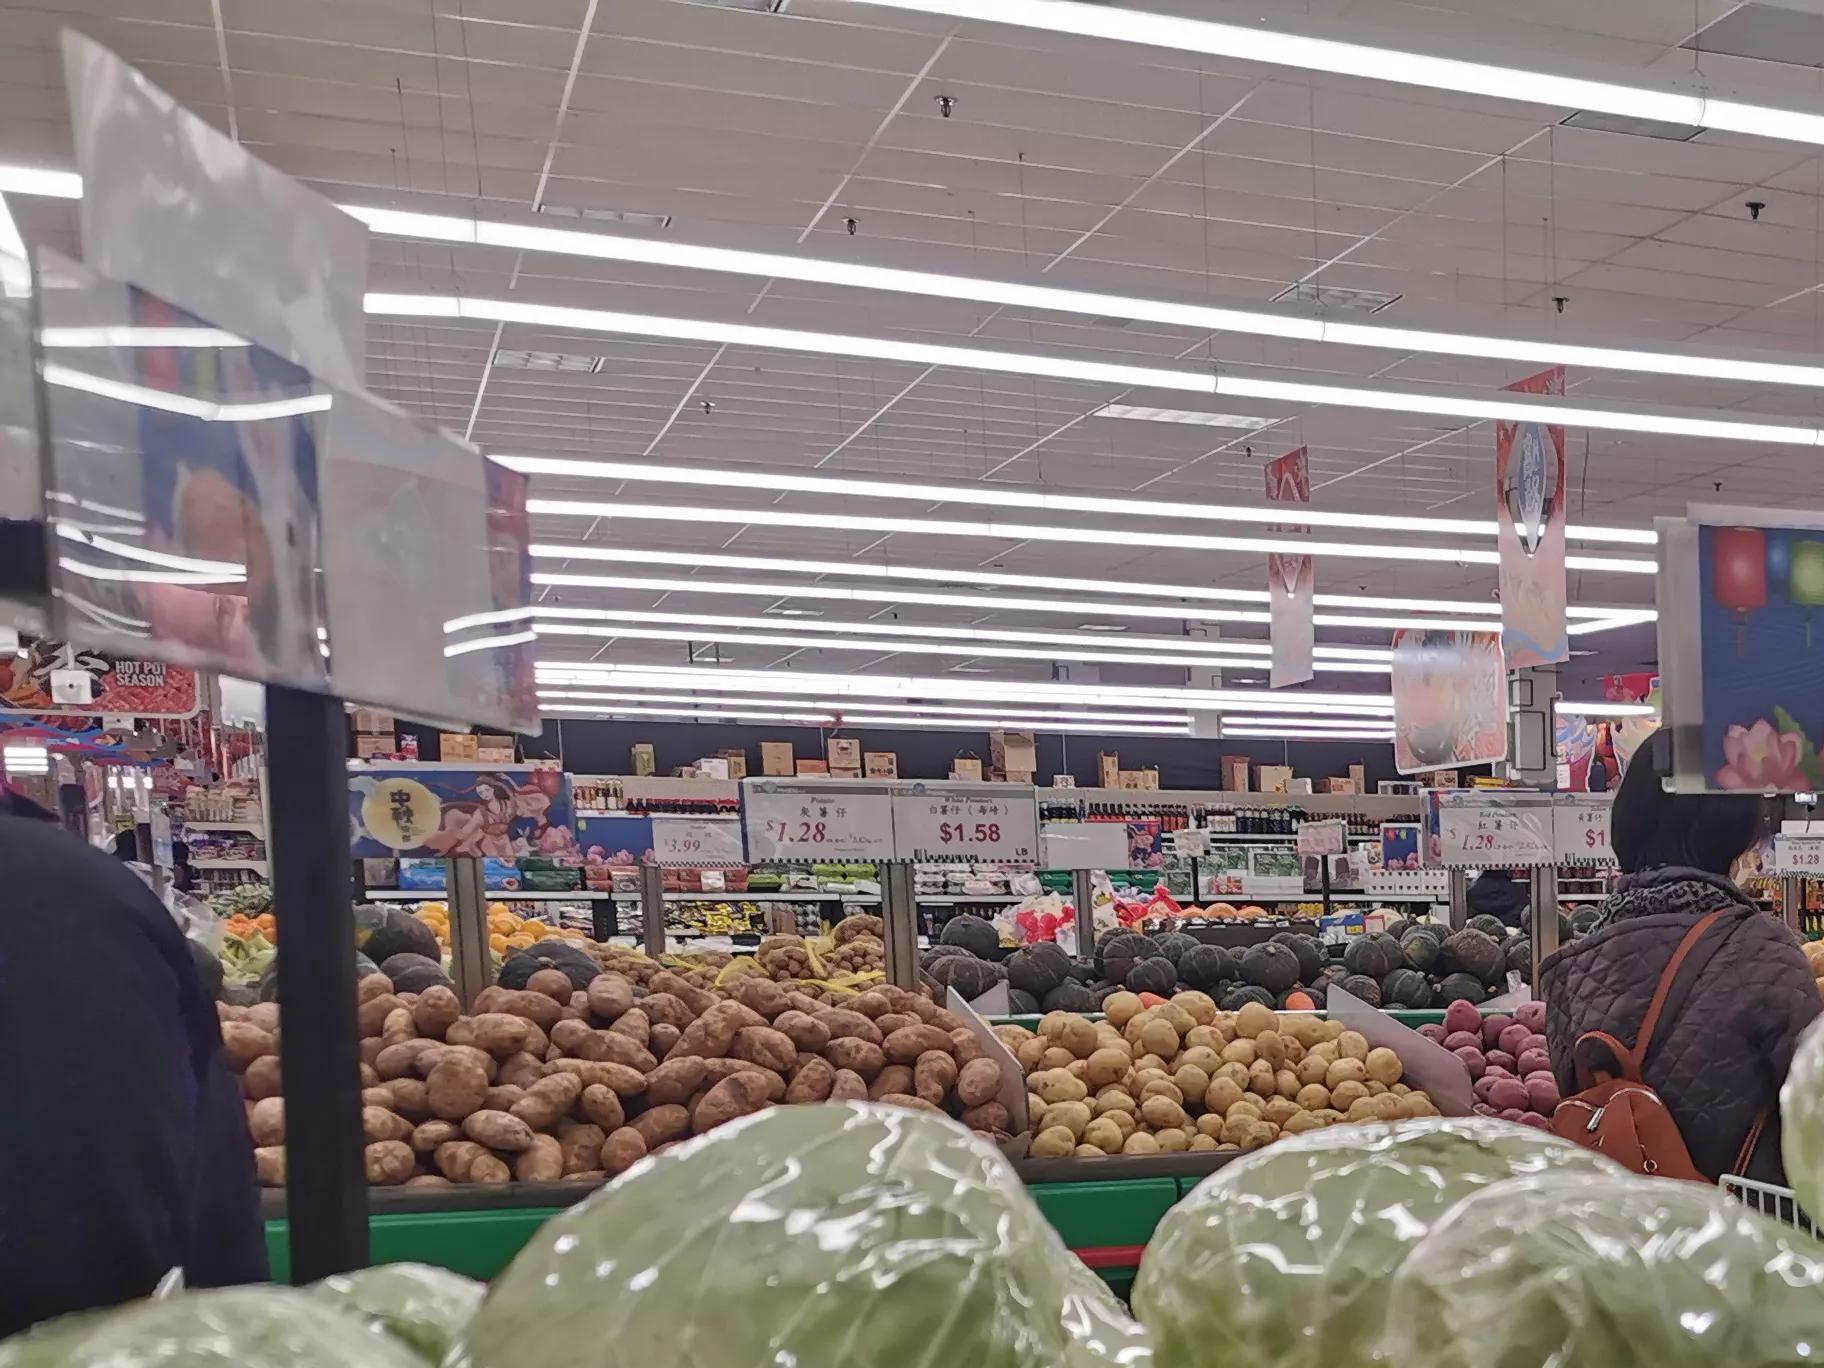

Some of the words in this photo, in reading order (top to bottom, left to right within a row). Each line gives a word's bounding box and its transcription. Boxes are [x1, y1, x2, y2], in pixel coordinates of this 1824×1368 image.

[115, 660, 141, 675] HOT
[116, 673, 165, 688] SEASON
[939, 822, 1001, 844] $1.58
